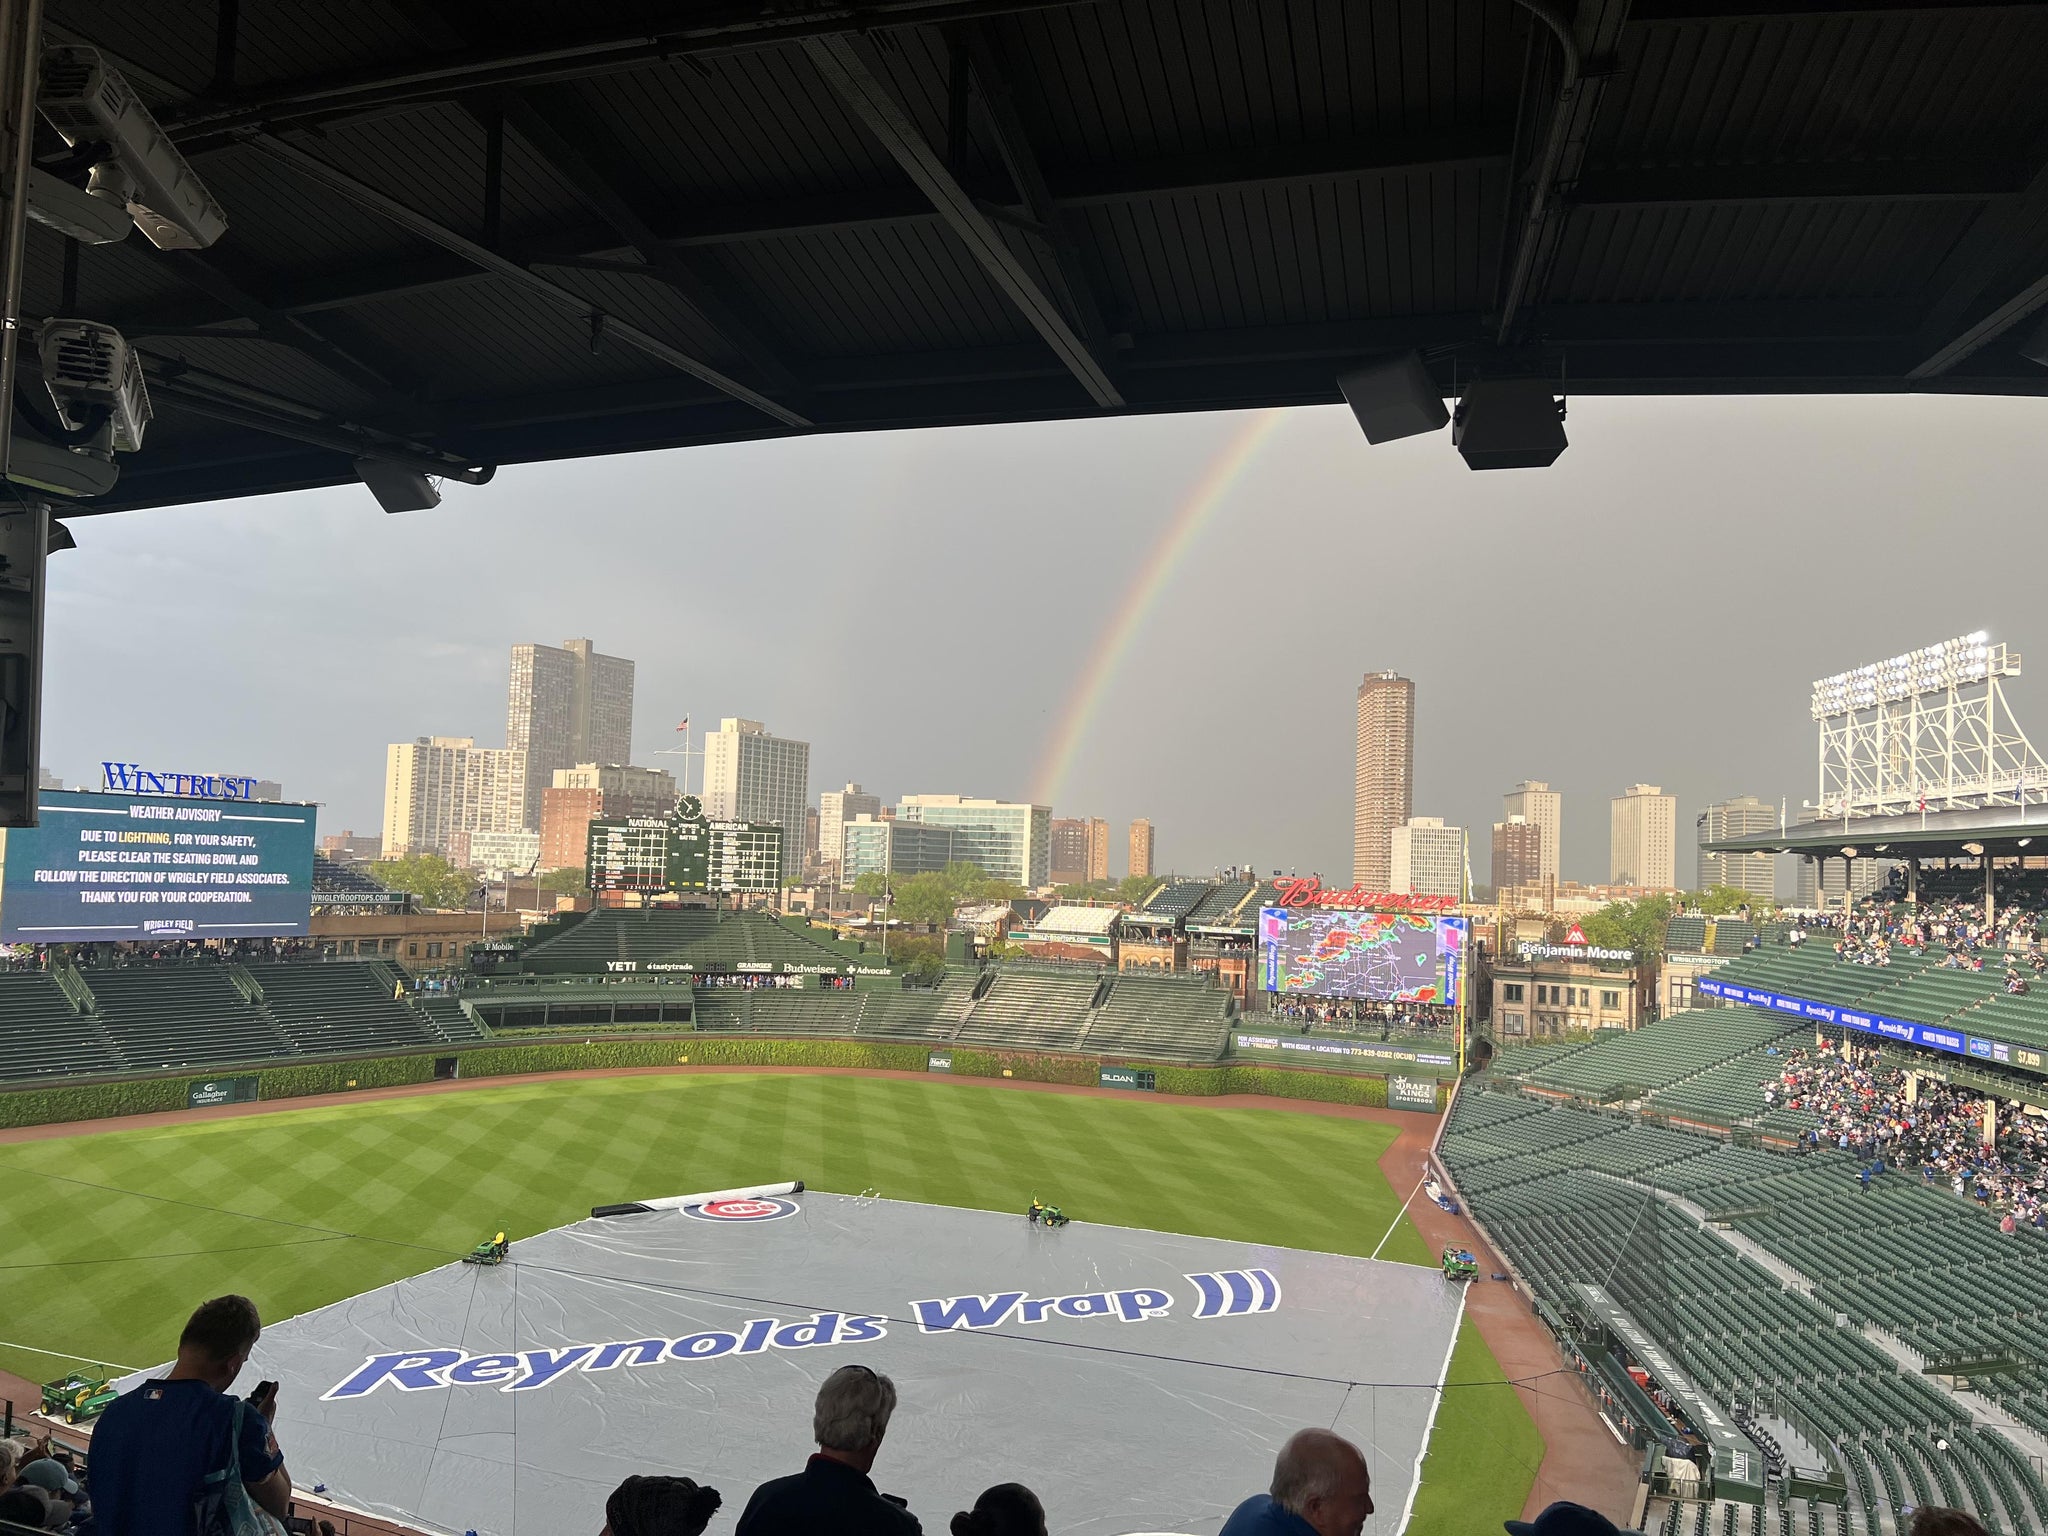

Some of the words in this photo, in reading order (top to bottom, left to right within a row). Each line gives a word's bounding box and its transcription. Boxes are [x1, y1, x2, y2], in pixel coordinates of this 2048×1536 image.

[101, 762, 257, 799] WINTRUST
[129, 805, 174, 819] WEATHER
[175, 808, 222, 821] ADVISORY
[628, 819, 669, 828] NATIONAL
[709, 822, 748, 831] AMERICAN
[81, 830, 102, 842] DUE
[103, 831, 117, 842] TO
[118, 832, 172, 845] LIGHTNING,
[174, 833, 192, 845] FOR
[194, 834, 220, 846] YOUR
[220, 835, 256, 848] SAFETY,
[78, 851, 118, 862] PLEASE
[118, 851, 150, 863] CLEAR
[152, 852, 171, 863] THE
[172, 853, 211, 865] SEATING
[212, 854, 238, 865] BOWL
[240, 855, 258, 866] AND
[34, 870, 77, 882] FOLLOW
[79, 871, 99, 883] THE
[100, 871, 152, 883] DIRECTION
[153, 872, 166, 883] OF
[168, 872, 209, 884] WRIGLEY
[210, 873, 234, 884] FIELD
[236, 873, 290, 885] ASSOCIATES.
[80, 891, 116, 903] THANK
[117, 891, 138, 903] YOU
[140, 891, 159, 903] FOR
[161, 891, 186, 903] YOUR
[188, 891, 252, 903] COOPERATION.
[1273, 876, 1458, 910] Budweiser
[144, 920, 174, 932] WRIGLEY
[174, 919, 194, 932] FIELD
[491, 943, 514, 951] Mobile
[1518, 942, 1583, 958] Benjamin
[1587, 946, 1632, 960] Moore
[607, 961, 637, 971] YETI
[653, 962, 694, 971] tastytrade
[857, 966, 892, 975] Advocate
[1316, 1045, 1342, 1054] LOCATION
[1350, 1048, 1393, 1059] 773-839-0282
[930, 1057, 950, 1067] Hefty
[1101, 1073, 1133, 1083] SLOAN
[1396, 1081, 1431, 1091] DRAFT
[192, 1090, 227, 1099] Gallagher
[1400, 1089, 1430, 1098] KINGS
[1395, 1095, 1433, 1104] SPORTSBOOK
[318, 1312, 888, 1400] Reynolds
[908, 1290, 1174, 1334] Wrap
